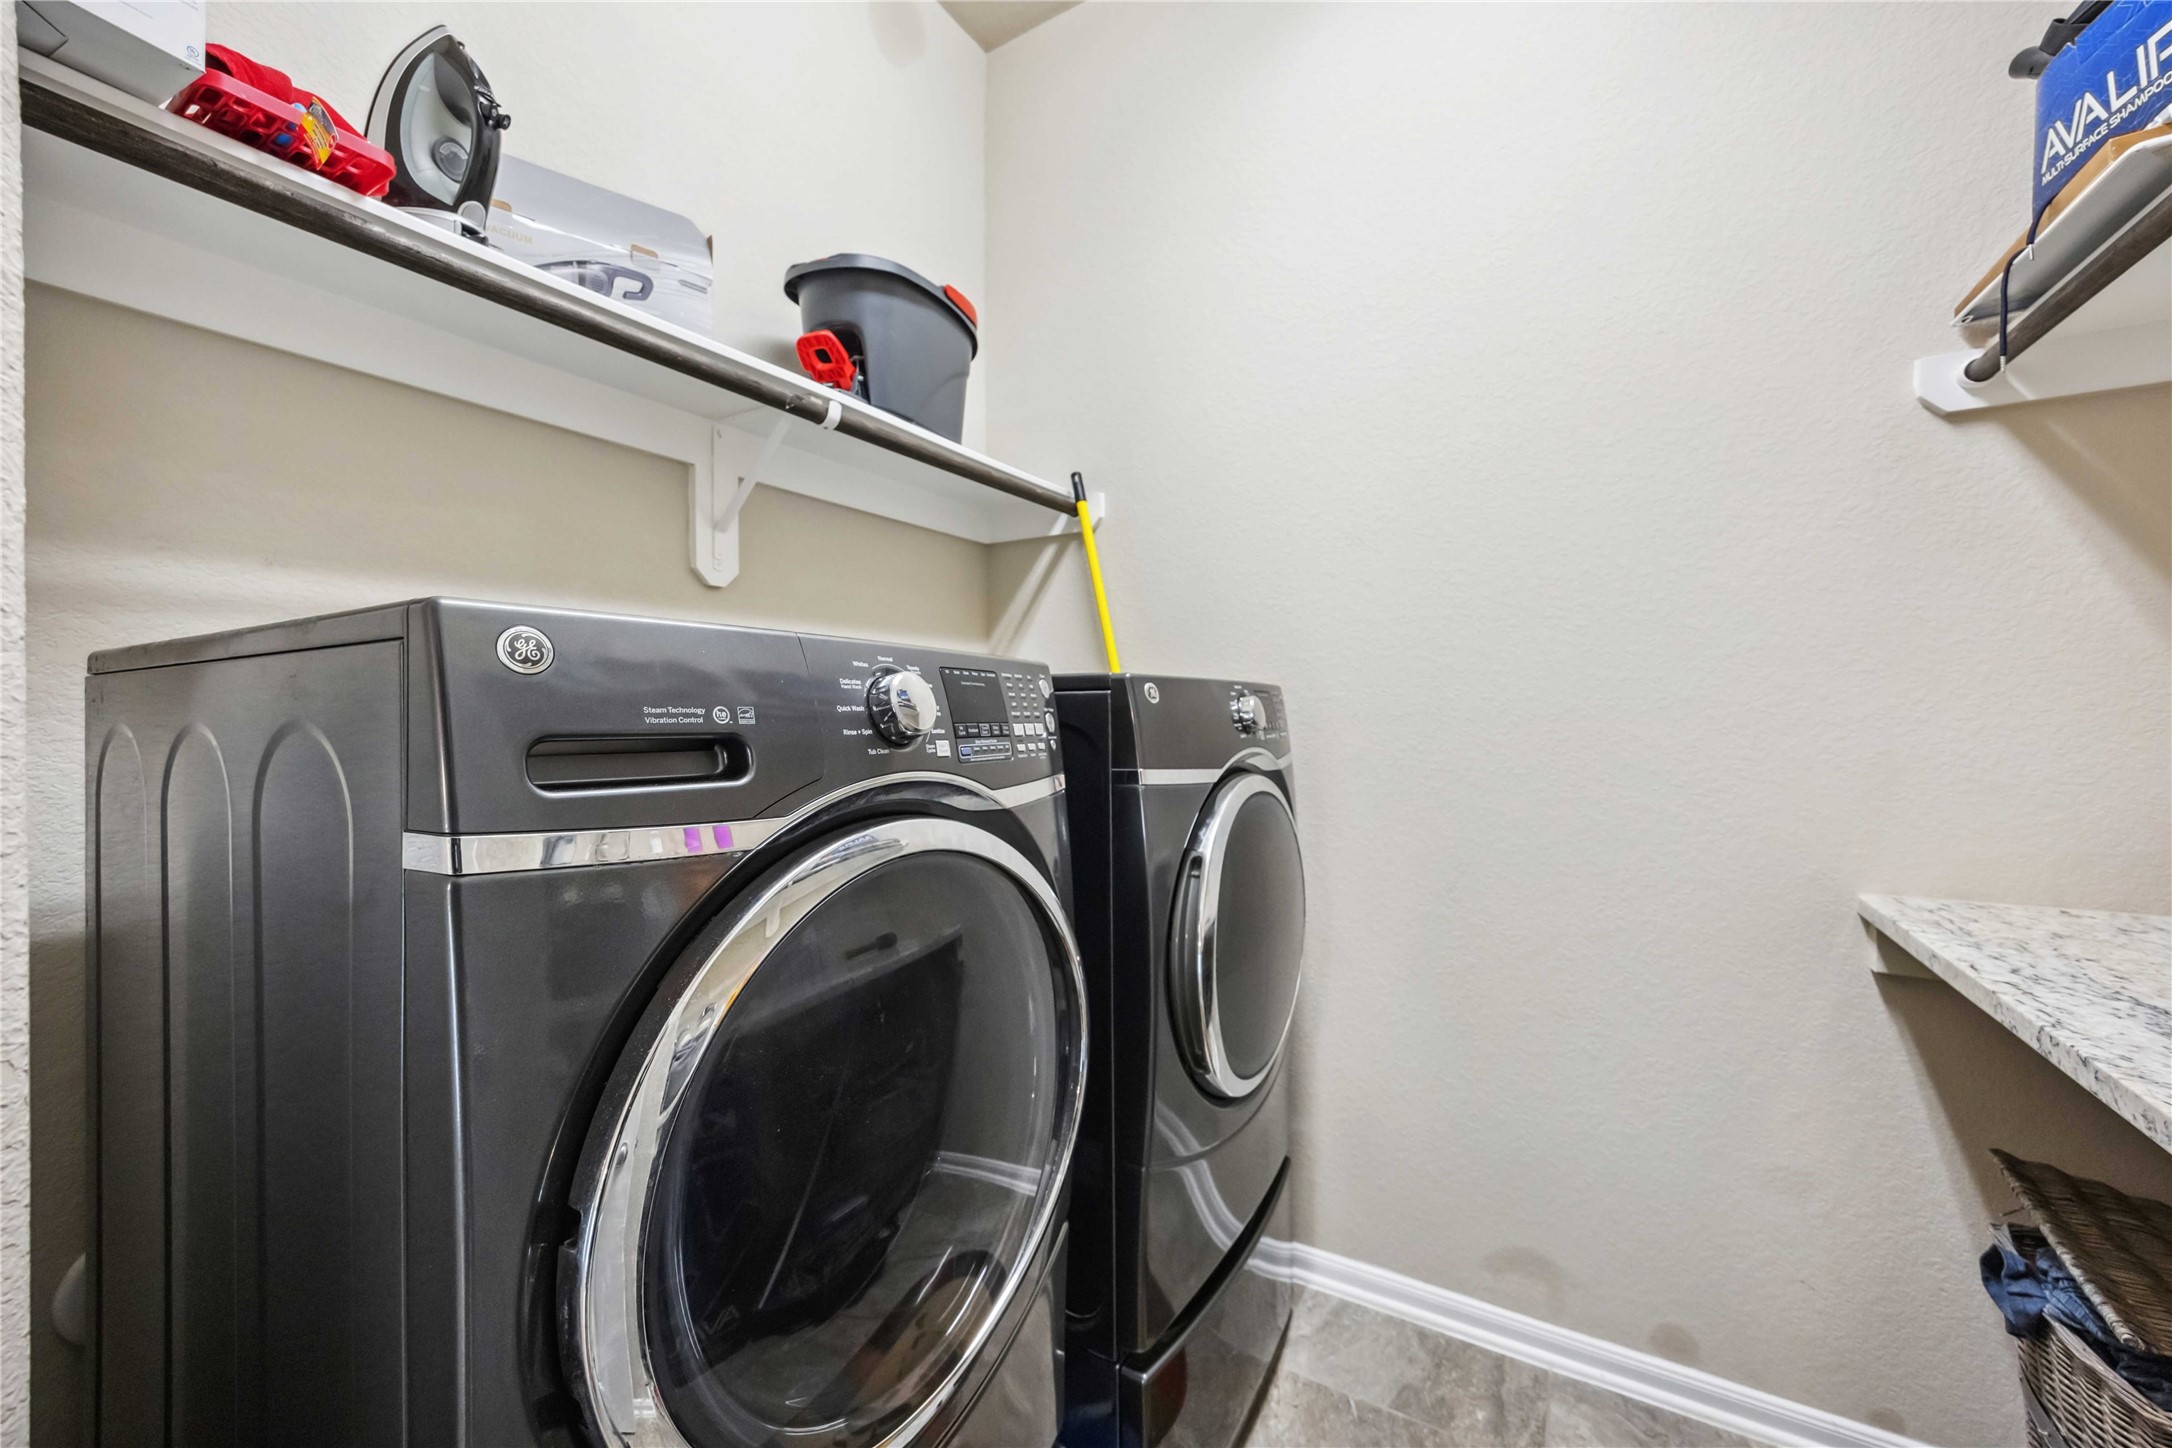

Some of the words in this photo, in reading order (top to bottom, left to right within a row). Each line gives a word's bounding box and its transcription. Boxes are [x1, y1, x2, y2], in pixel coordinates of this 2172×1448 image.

[2041, 121, 2109, 186] MULTI-SURFACE
[513, 638, 541, 661] GE
[643, 706, 667, 714] Steam
[667, 706, 706, 715] Technology
[836, 705, 851, 713] Quick
[644, 716, 677, 724] Vibration
[678, 716, 704, 724] Control
[862, 728, 873, 736] Spin
